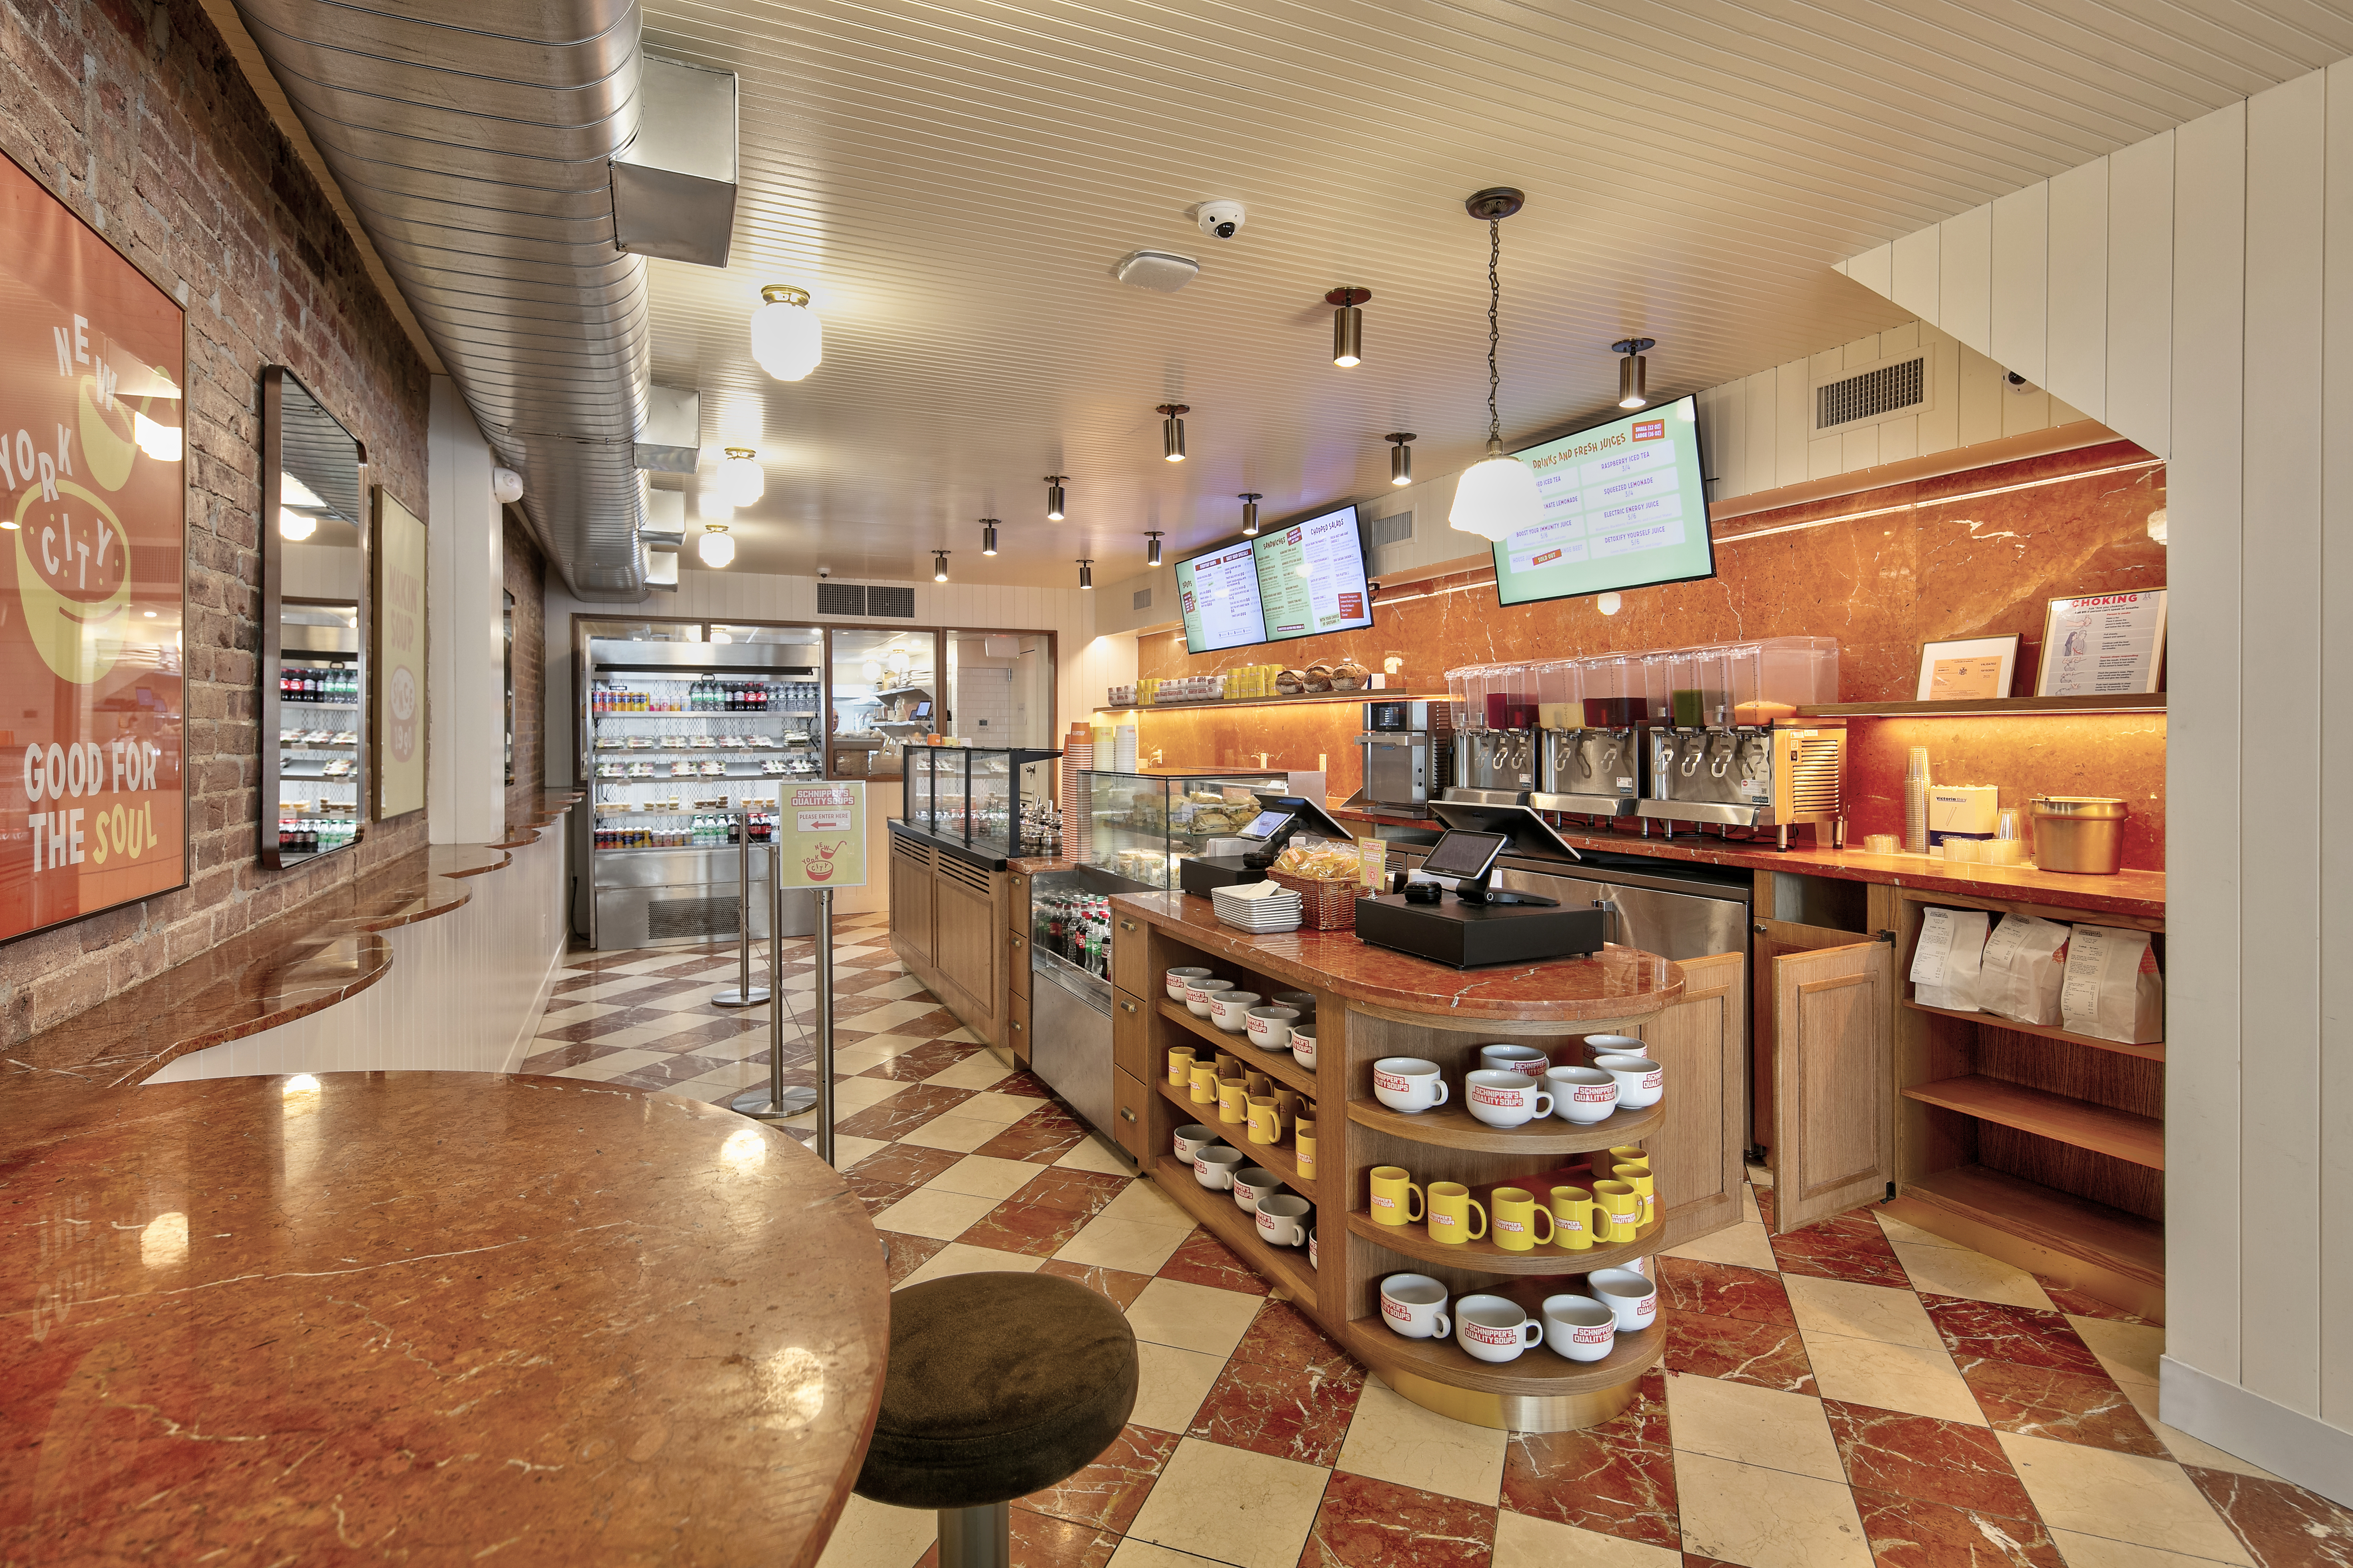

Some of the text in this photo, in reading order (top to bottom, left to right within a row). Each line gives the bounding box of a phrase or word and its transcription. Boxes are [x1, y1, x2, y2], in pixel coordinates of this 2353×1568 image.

[54, 313, 117, 411] NEW
[1635, 424, 1647, 434] SMALL
[1635, 431, 1647, 440] LARGE
[1532, 432, 1626, 470] DRINKS AND FRESH JUICES
[0, 423, 72, 502] YORK
[1601, 457, 1628, 470] RASPBERRY
[1629, 454, 1639, 462] ICED
[1604, 477, 1653, 495] SQUEEZED LEMONADE
[1556, 496, 1578, 506] LEMONADE
[1604, 508, 1624, 517] ELECTRIC
[1626, 504, 1644, 513] ENERGY
[1310, 518, 1344, 536] CHOPPED SALADS
[1539, 523, 1559, 532] IMMUNITY
[1604, 534, 1626, 543] DETOXIFY
[1627, 529, 1650, 539] YOURSELF
[1263, 536, 1285, 550] SANDWICHES
[42, 513, 113, 589] CITY
[1537, 554, 1547, 562] SOLD
[389, 563, 419, 614] MAKIN'
[1182, 580, 1192, 588] SOUPS
[2072, 594, 2137, 607] CHOKING
[391, 609, 414, 653] SOUP
[394, 677, 413, 713] SINCE
[395, 725, 411, 755] 1990
[24, 742, 157, 802] GOOD FOR
[798, 789, 848, 798] SCHNIPPER'S
[29, 800, 157, 872] THE SOUL
[815, 842, 829, 850] NEW
[802, 855, 819, 864] YORK
[812, 863, 828, 871] CITY
[1476, 1087, 1518, 1098] SCHNIPPER'S
[1579, 1085, 1615, 1094] SCHNIPPER'S
[1473, 1093, 1522, 1106] QUALITY SOUPS
[1575, 1093, 1604, 1101] QUALITY
[1495, 1217, 1521, 1227] SCHNIPPER'S
[1554, 1216, 1579, 1226] SCHNIPPER'S
[1390, 1310, 1410, 1320] SOUPS
[1466, 1329, 1516, 1344] QUALITY SOUPS
[1469, 1324, 1512, 1337] SCHNIPPER'S
